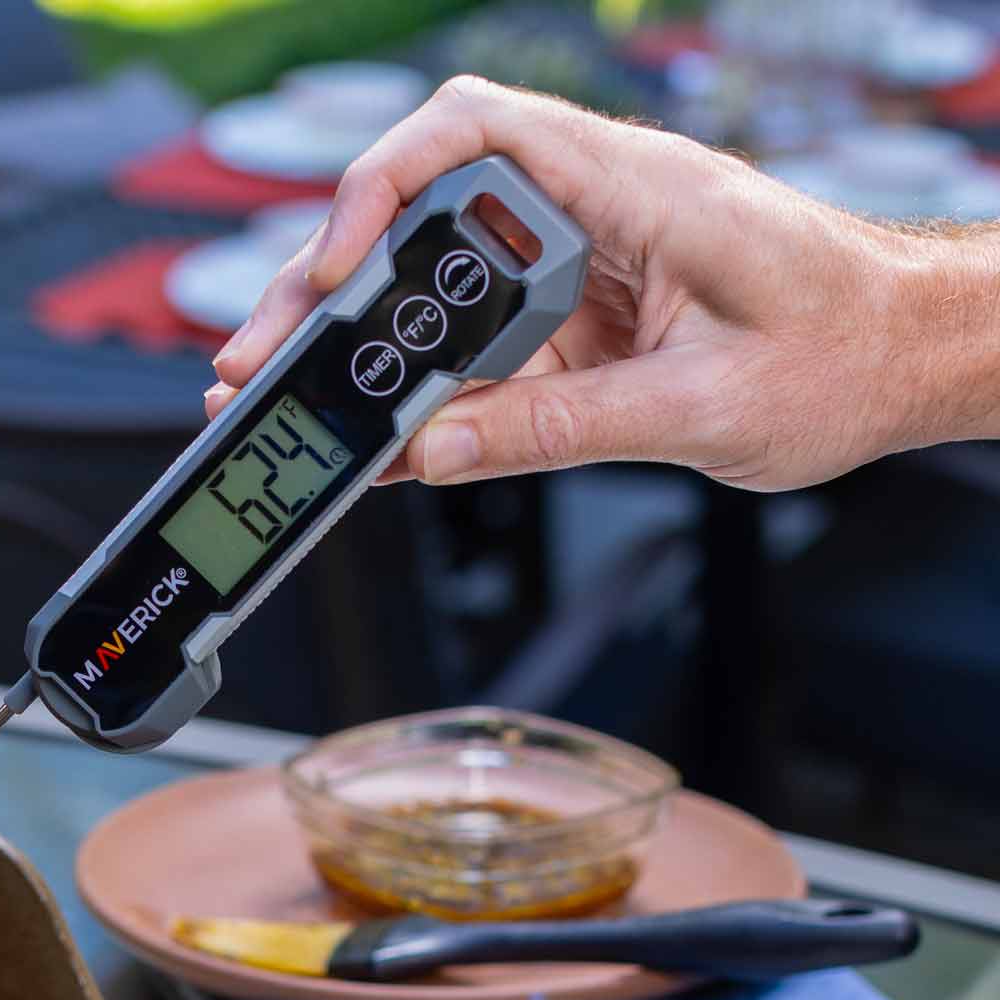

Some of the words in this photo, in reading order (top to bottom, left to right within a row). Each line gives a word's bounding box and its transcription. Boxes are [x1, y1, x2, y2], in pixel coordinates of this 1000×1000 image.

[450, 264, 485, 301] ROTATE
[358, 349, 397, 387] TIMER
[206, 413, 334, 544] 62.4
